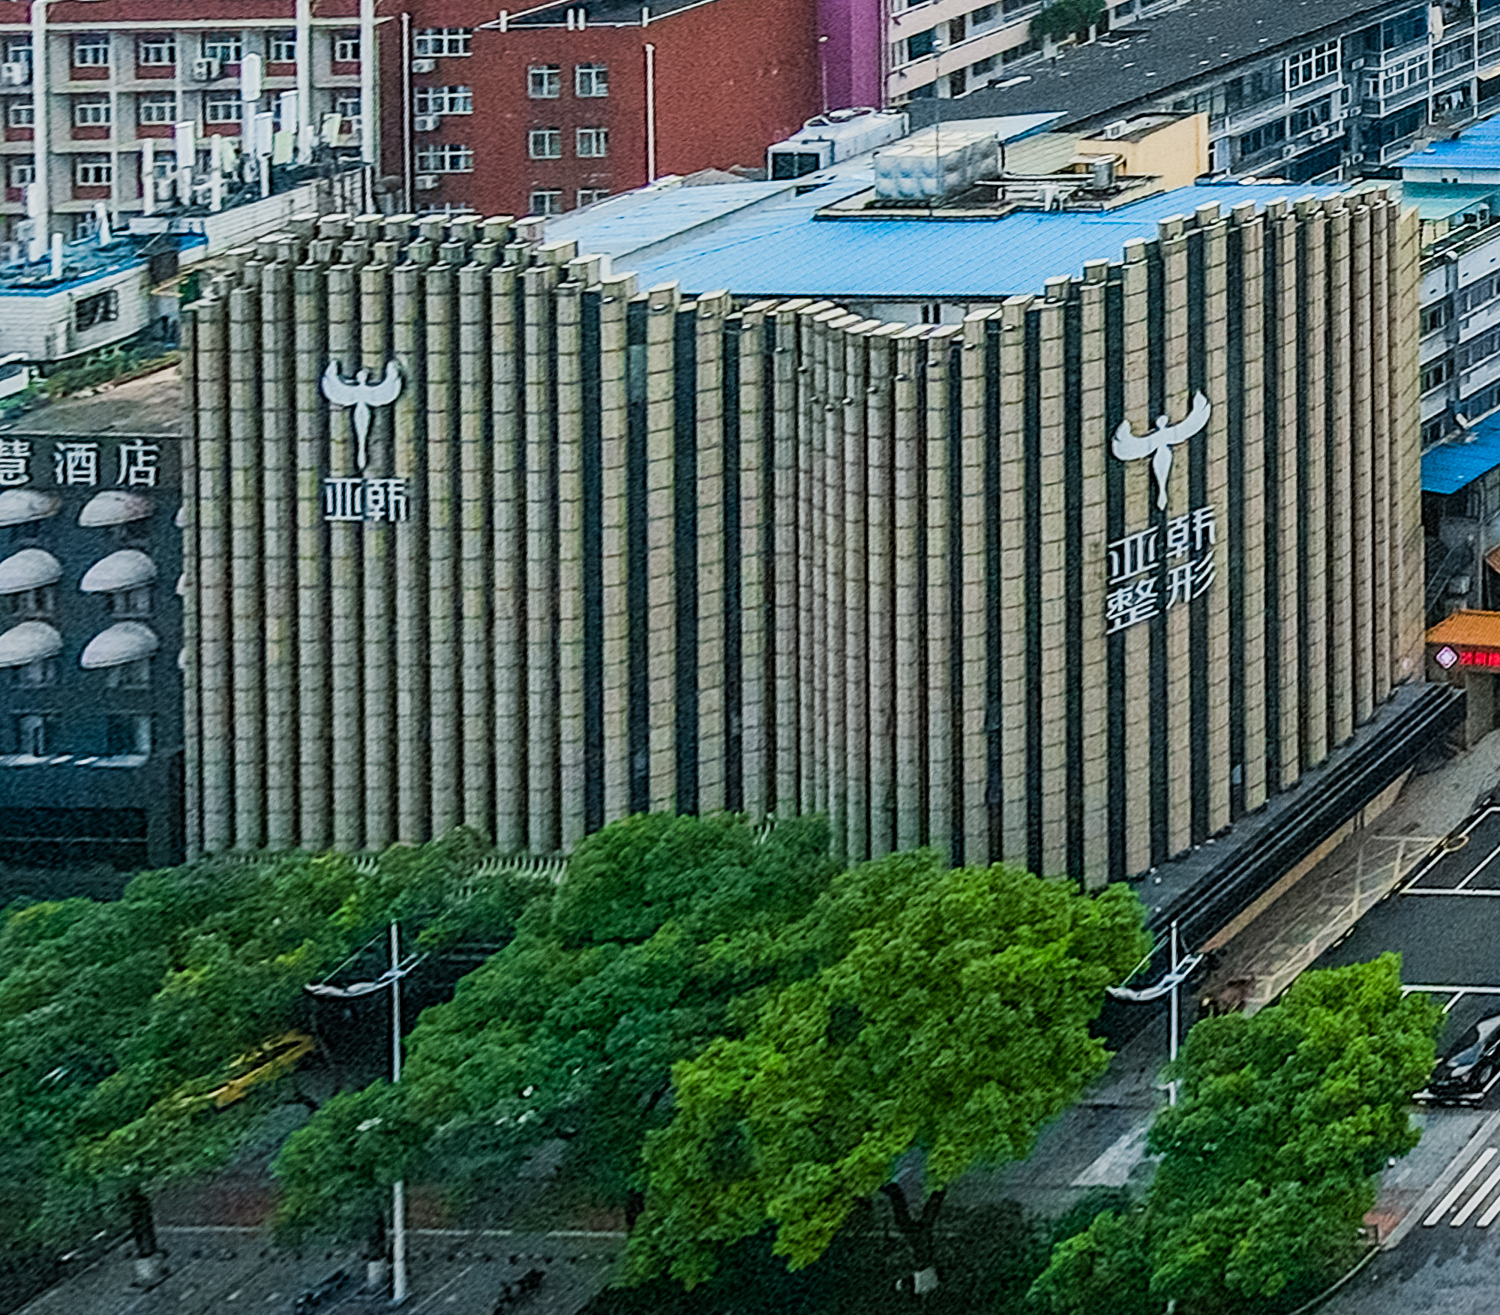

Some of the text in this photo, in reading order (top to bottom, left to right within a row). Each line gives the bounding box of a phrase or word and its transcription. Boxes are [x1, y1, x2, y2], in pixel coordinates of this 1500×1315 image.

[324, 478, 408, 522] 亚韩
[1107, 504, 1216, 585] 亚韩
[1106, 549, 1217, 635] 整形
